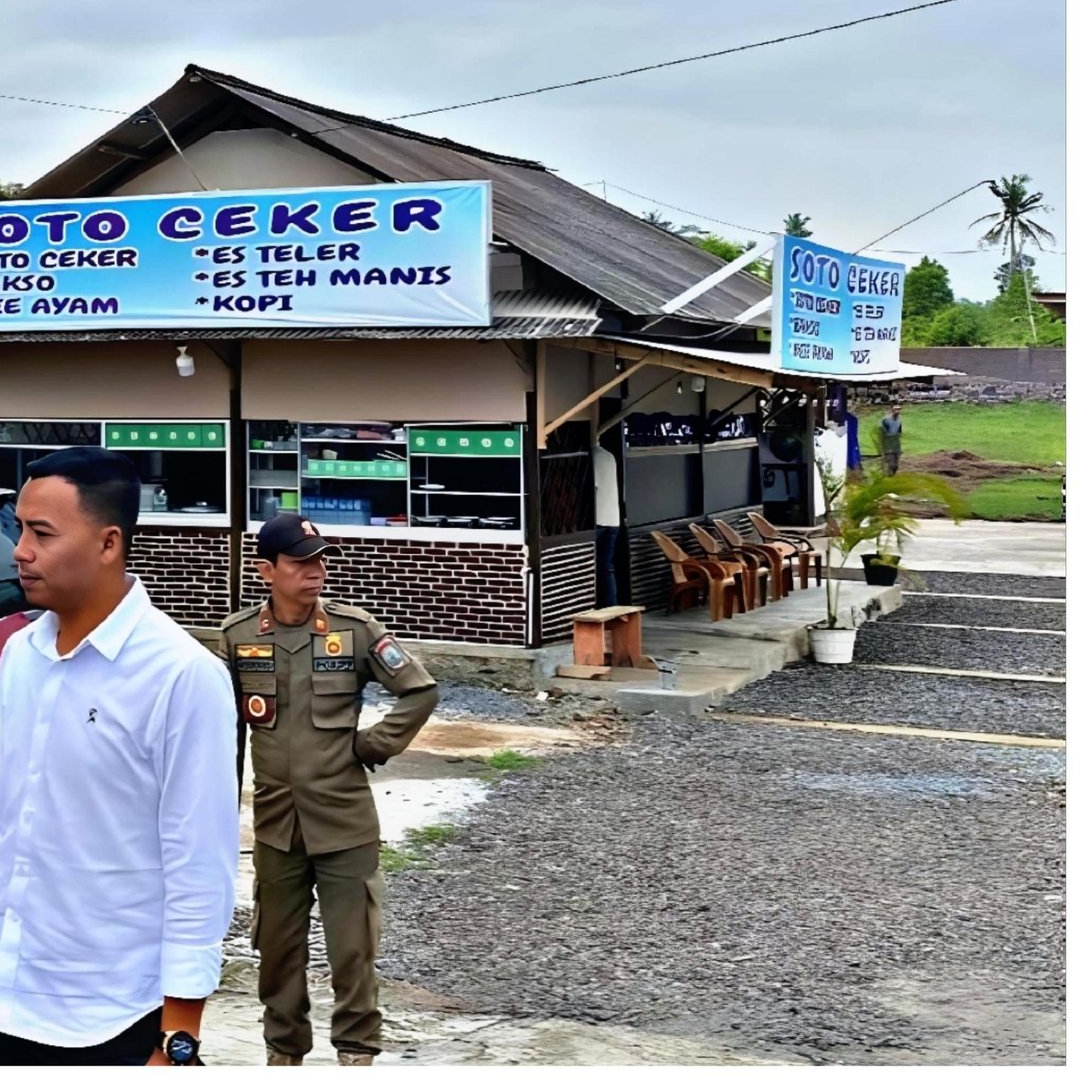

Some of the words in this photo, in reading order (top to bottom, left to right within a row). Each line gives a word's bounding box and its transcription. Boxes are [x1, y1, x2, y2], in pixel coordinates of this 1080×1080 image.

[159, 198, 443, 240] CEKER
[39, 249, 138, 269] CEKER
[255, 242, 361, 263] TELER
[256, 269, 317, 287] TEH
[329, 266, 452, 286] MANIS
[790, 247, 840, 290] SOTO
[847, 264, 900, 297] CEKER
[30, 297, 119, 315] AYAM
